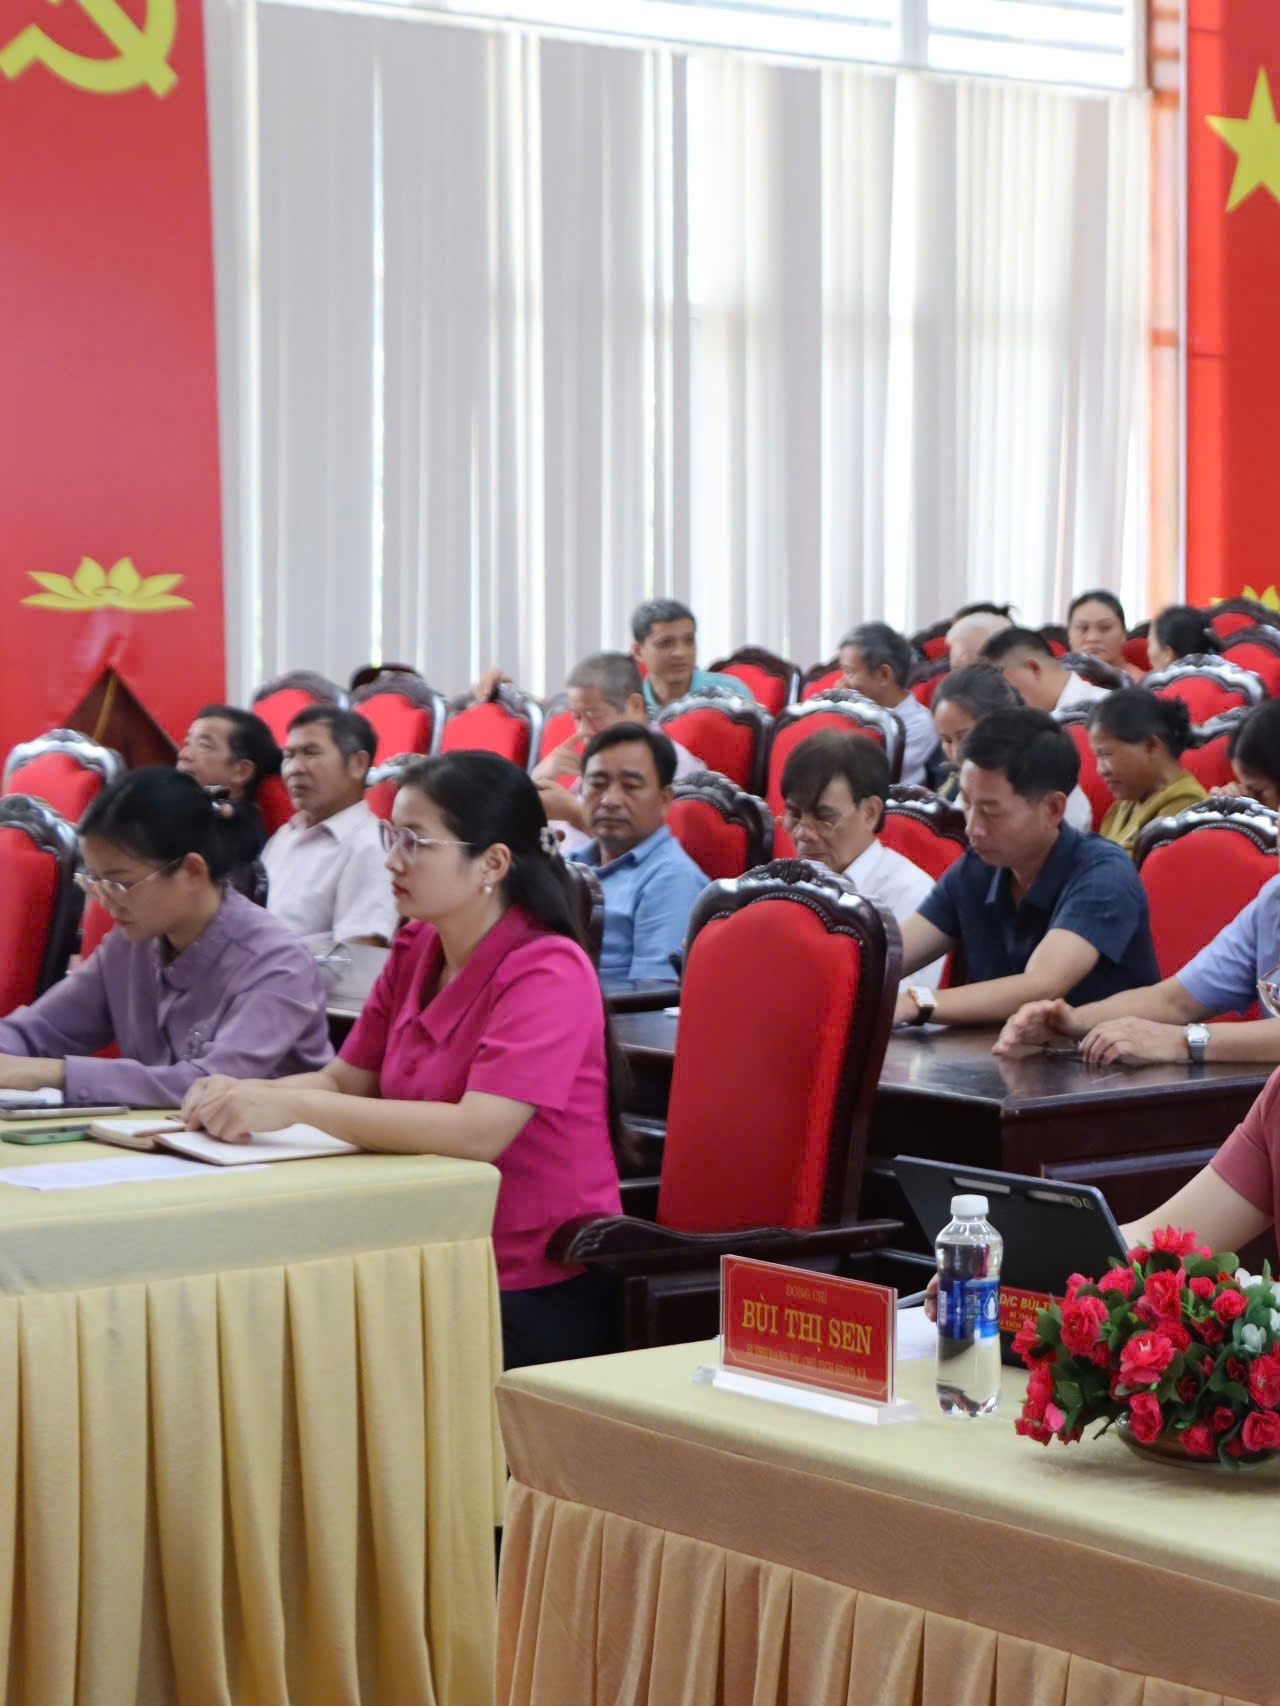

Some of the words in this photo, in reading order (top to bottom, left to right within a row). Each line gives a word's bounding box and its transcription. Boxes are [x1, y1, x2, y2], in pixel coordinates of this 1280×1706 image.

[742, 1294, 778, 1335] BÙI
[785, 1308, 822, 1352] THỊ
[828, 1317, 873, 1356] SEN
